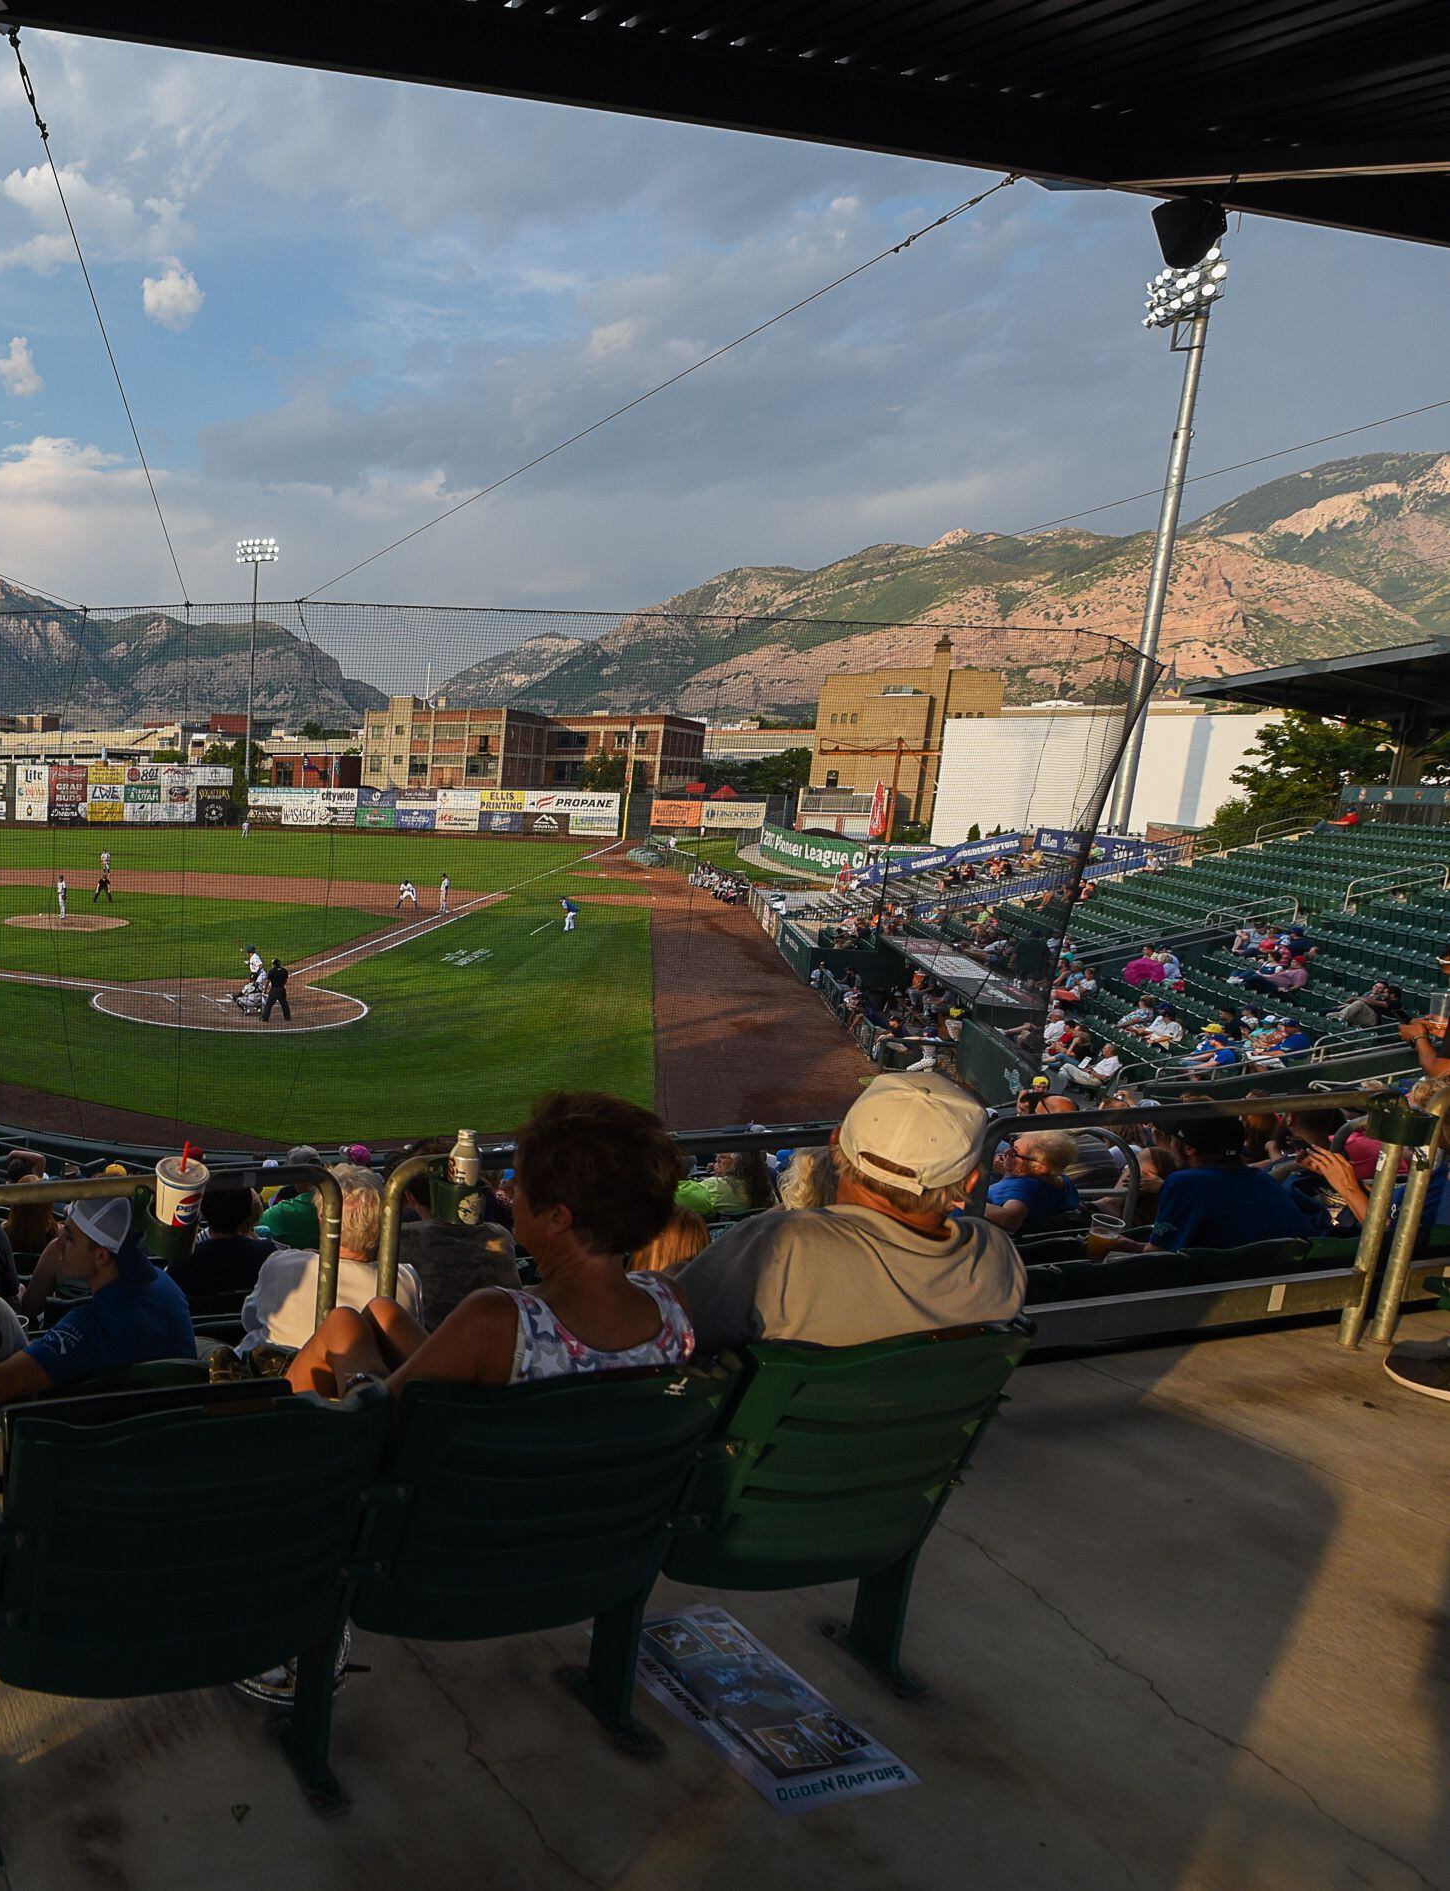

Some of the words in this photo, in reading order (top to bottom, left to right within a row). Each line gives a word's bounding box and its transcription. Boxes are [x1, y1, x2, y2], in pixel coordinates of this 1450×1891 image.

[25, 769, 43, 783] Lite
[141, 767, 159, 781] 801
[55, 783, 83, 791] GRAB
[55, 794, 83, 802] BUDS
[321, 790, 355, 802] citywide
[489, 791, 515, 801] ELLIS
[479, 801, 523, 810] PRINTING
[555, 798, 614, 808] PROPANE
[283, 808, 316, 823] WASATCH
[437, 813, 454, 823] ACE
[775, 834, 803, 858] Pioneer
[804, 843, 849, 868] League
[910, 854, 947, 869] COMMENT
[775, 1778, 836, 1802] OGDEN
[836, 1764, 907, 1794] RAPTORS
